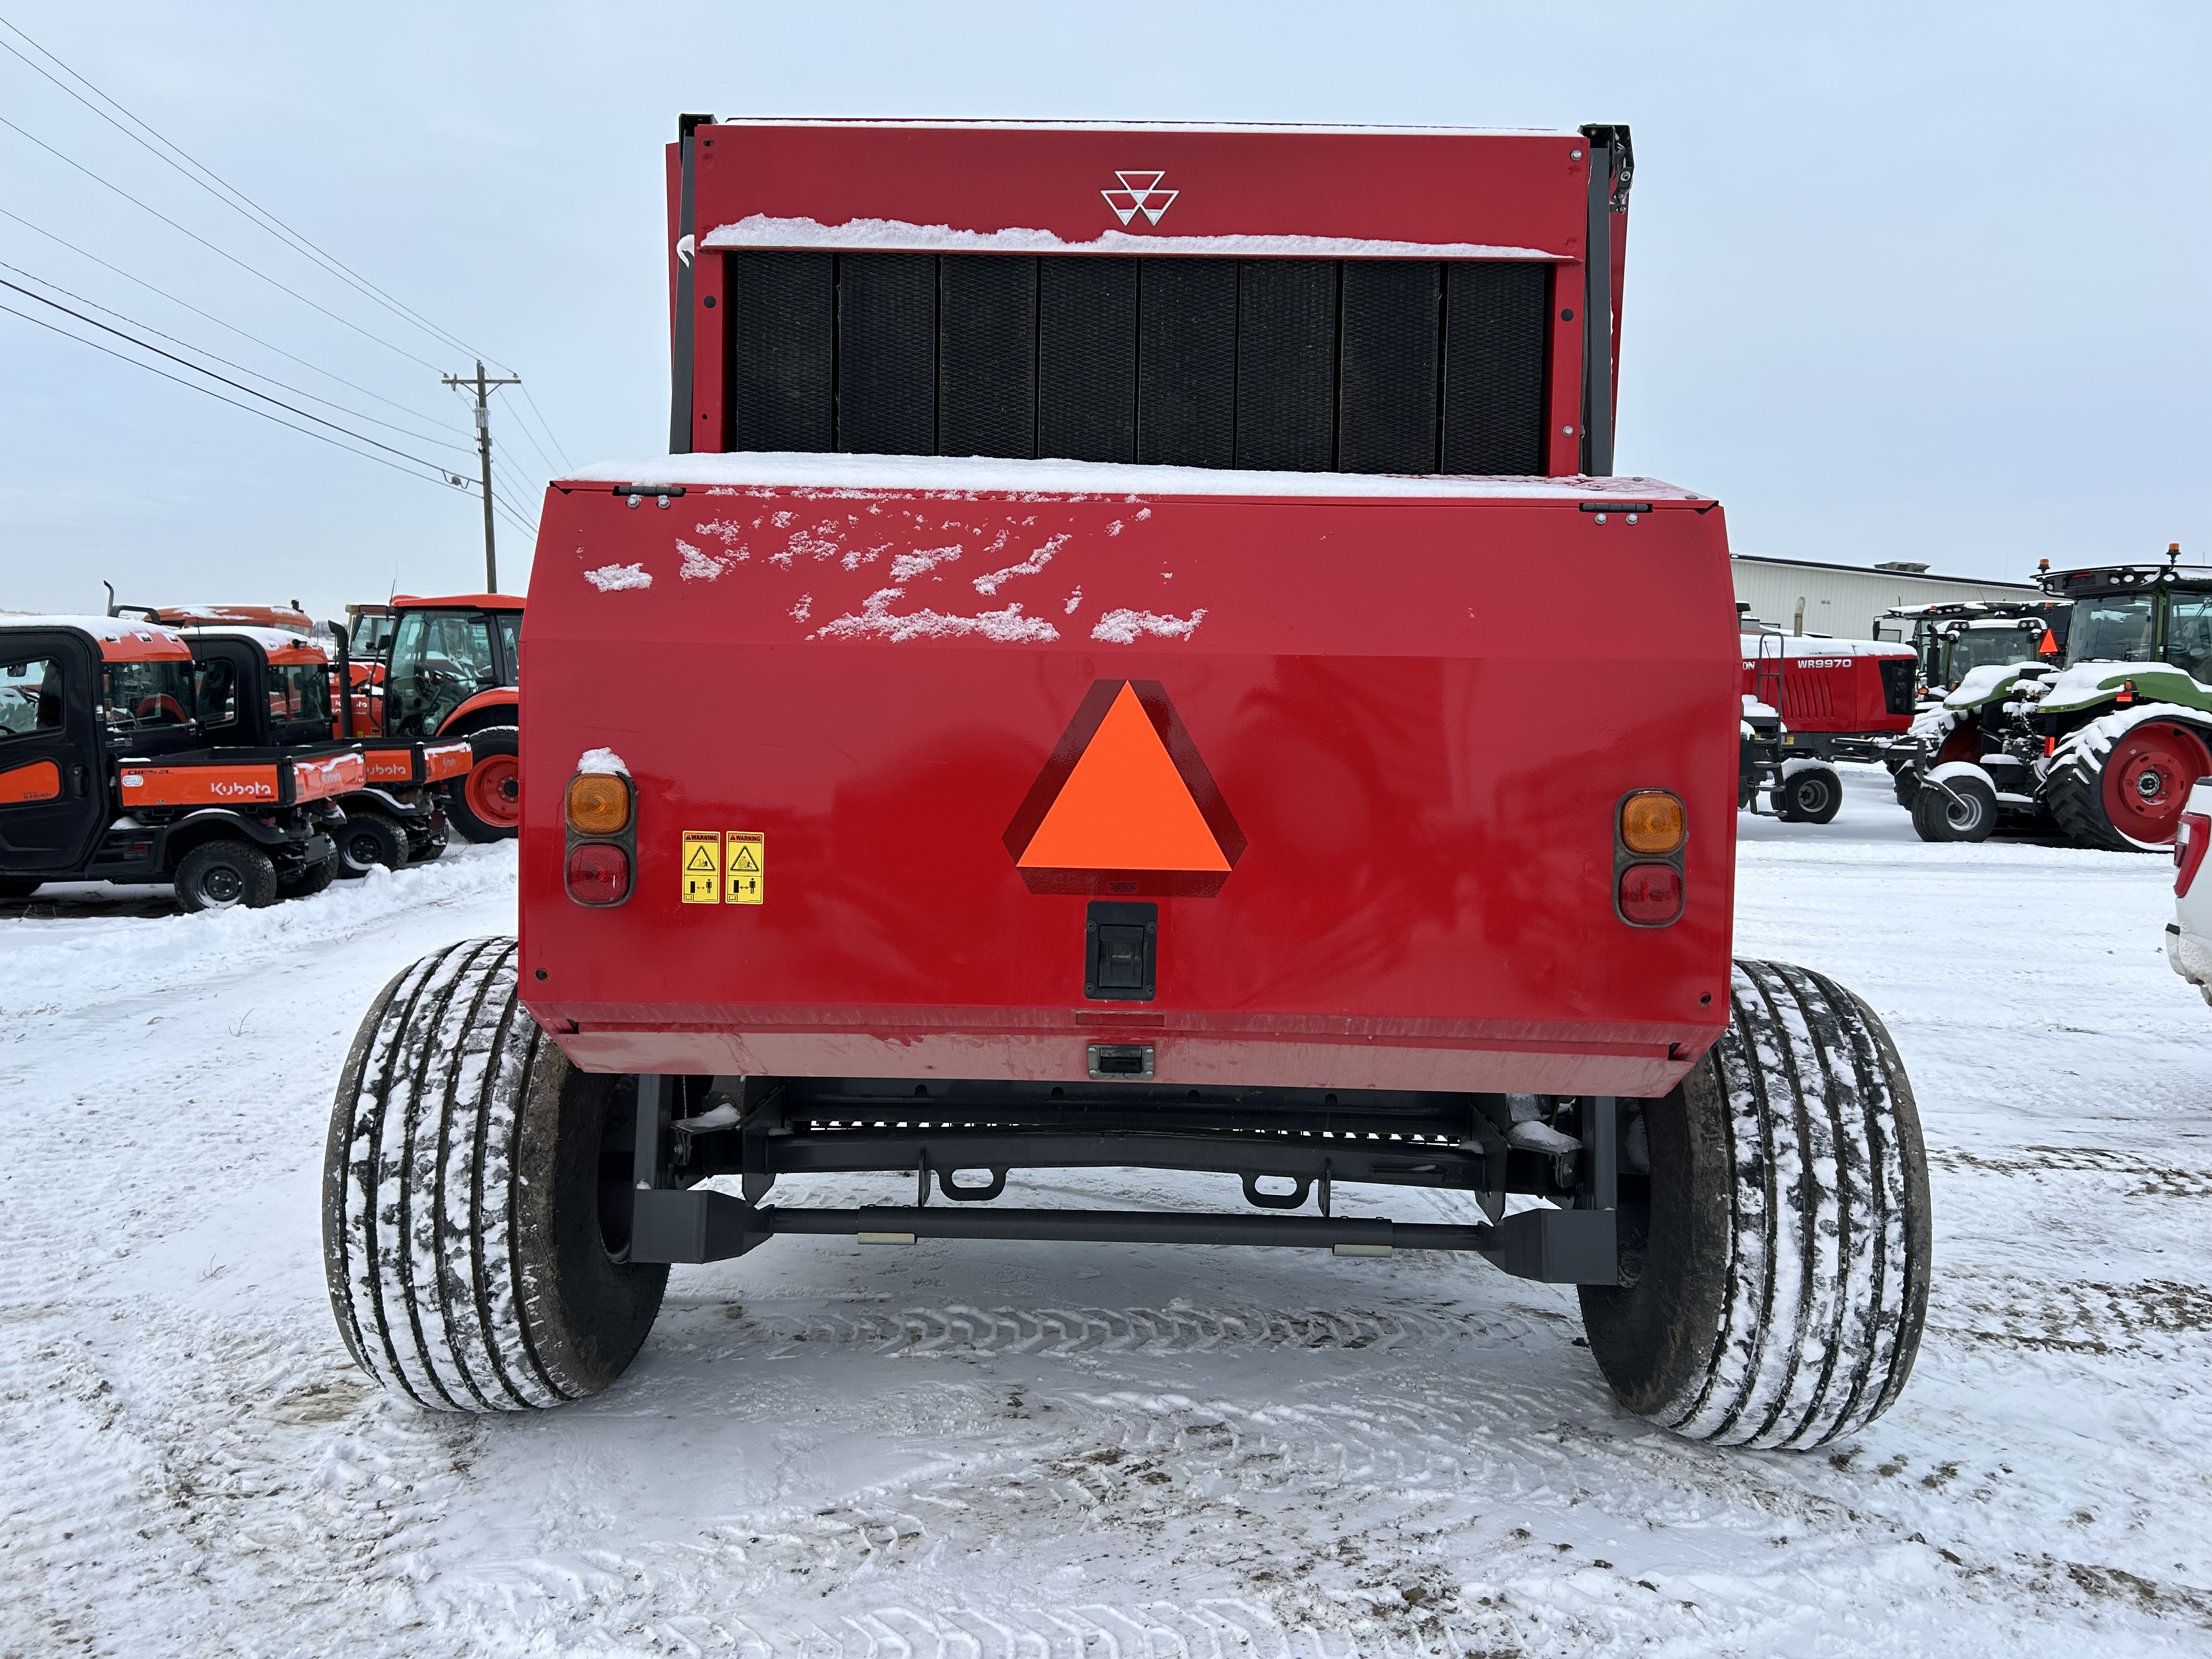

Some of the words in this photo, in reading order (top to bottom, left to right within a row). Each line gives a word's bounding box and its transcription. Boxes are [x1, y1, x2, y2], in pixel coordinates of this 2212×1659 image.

[1742, 662, 1756, 670] ON
[1798, 659, 1852, 669] WR9970
[367, 764, 406, 775] ubota
[211, 782, 271, 795] Kubota
